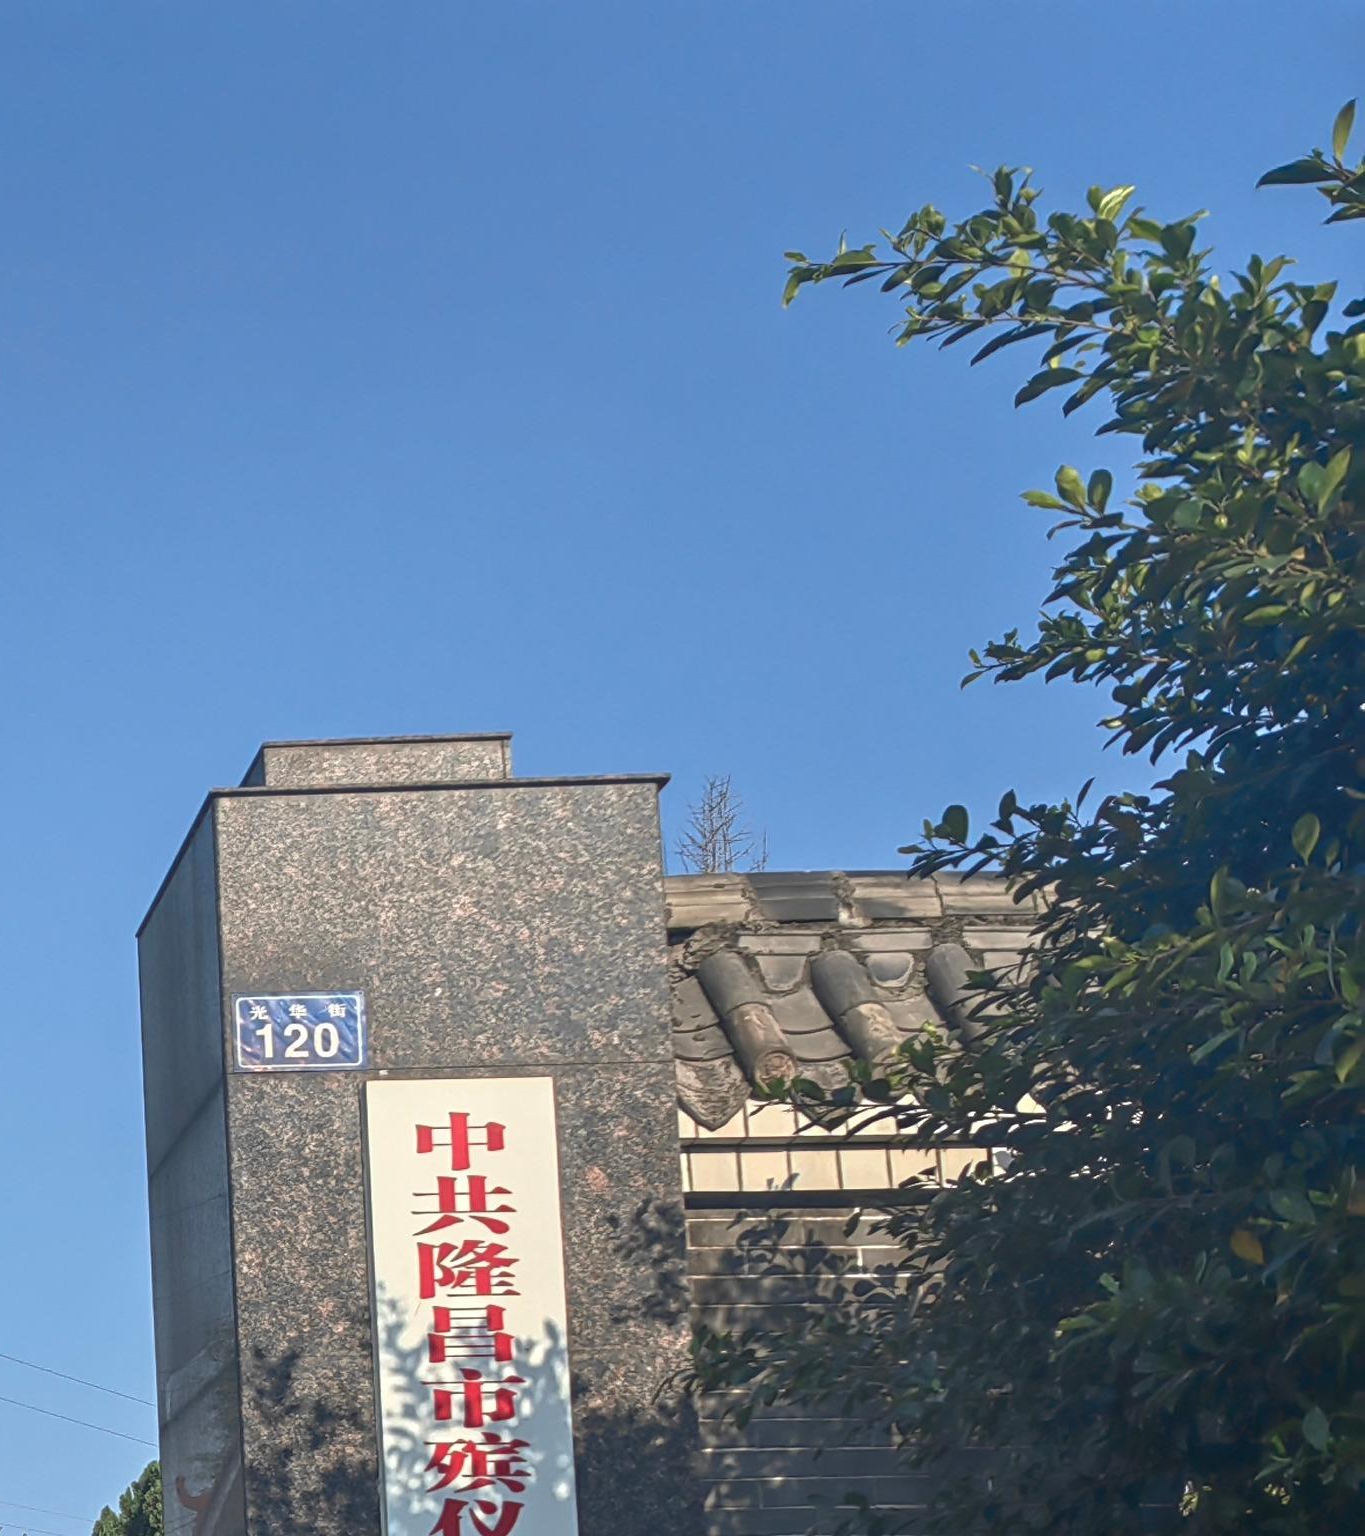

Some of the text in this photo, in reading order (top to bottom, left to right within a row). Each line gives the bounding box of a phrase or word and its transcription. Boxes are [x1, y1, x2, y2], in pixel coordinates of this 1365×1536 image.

[249, 1004, 346, 1020] 光华街
[255, 1022, 340, 1058] 120
